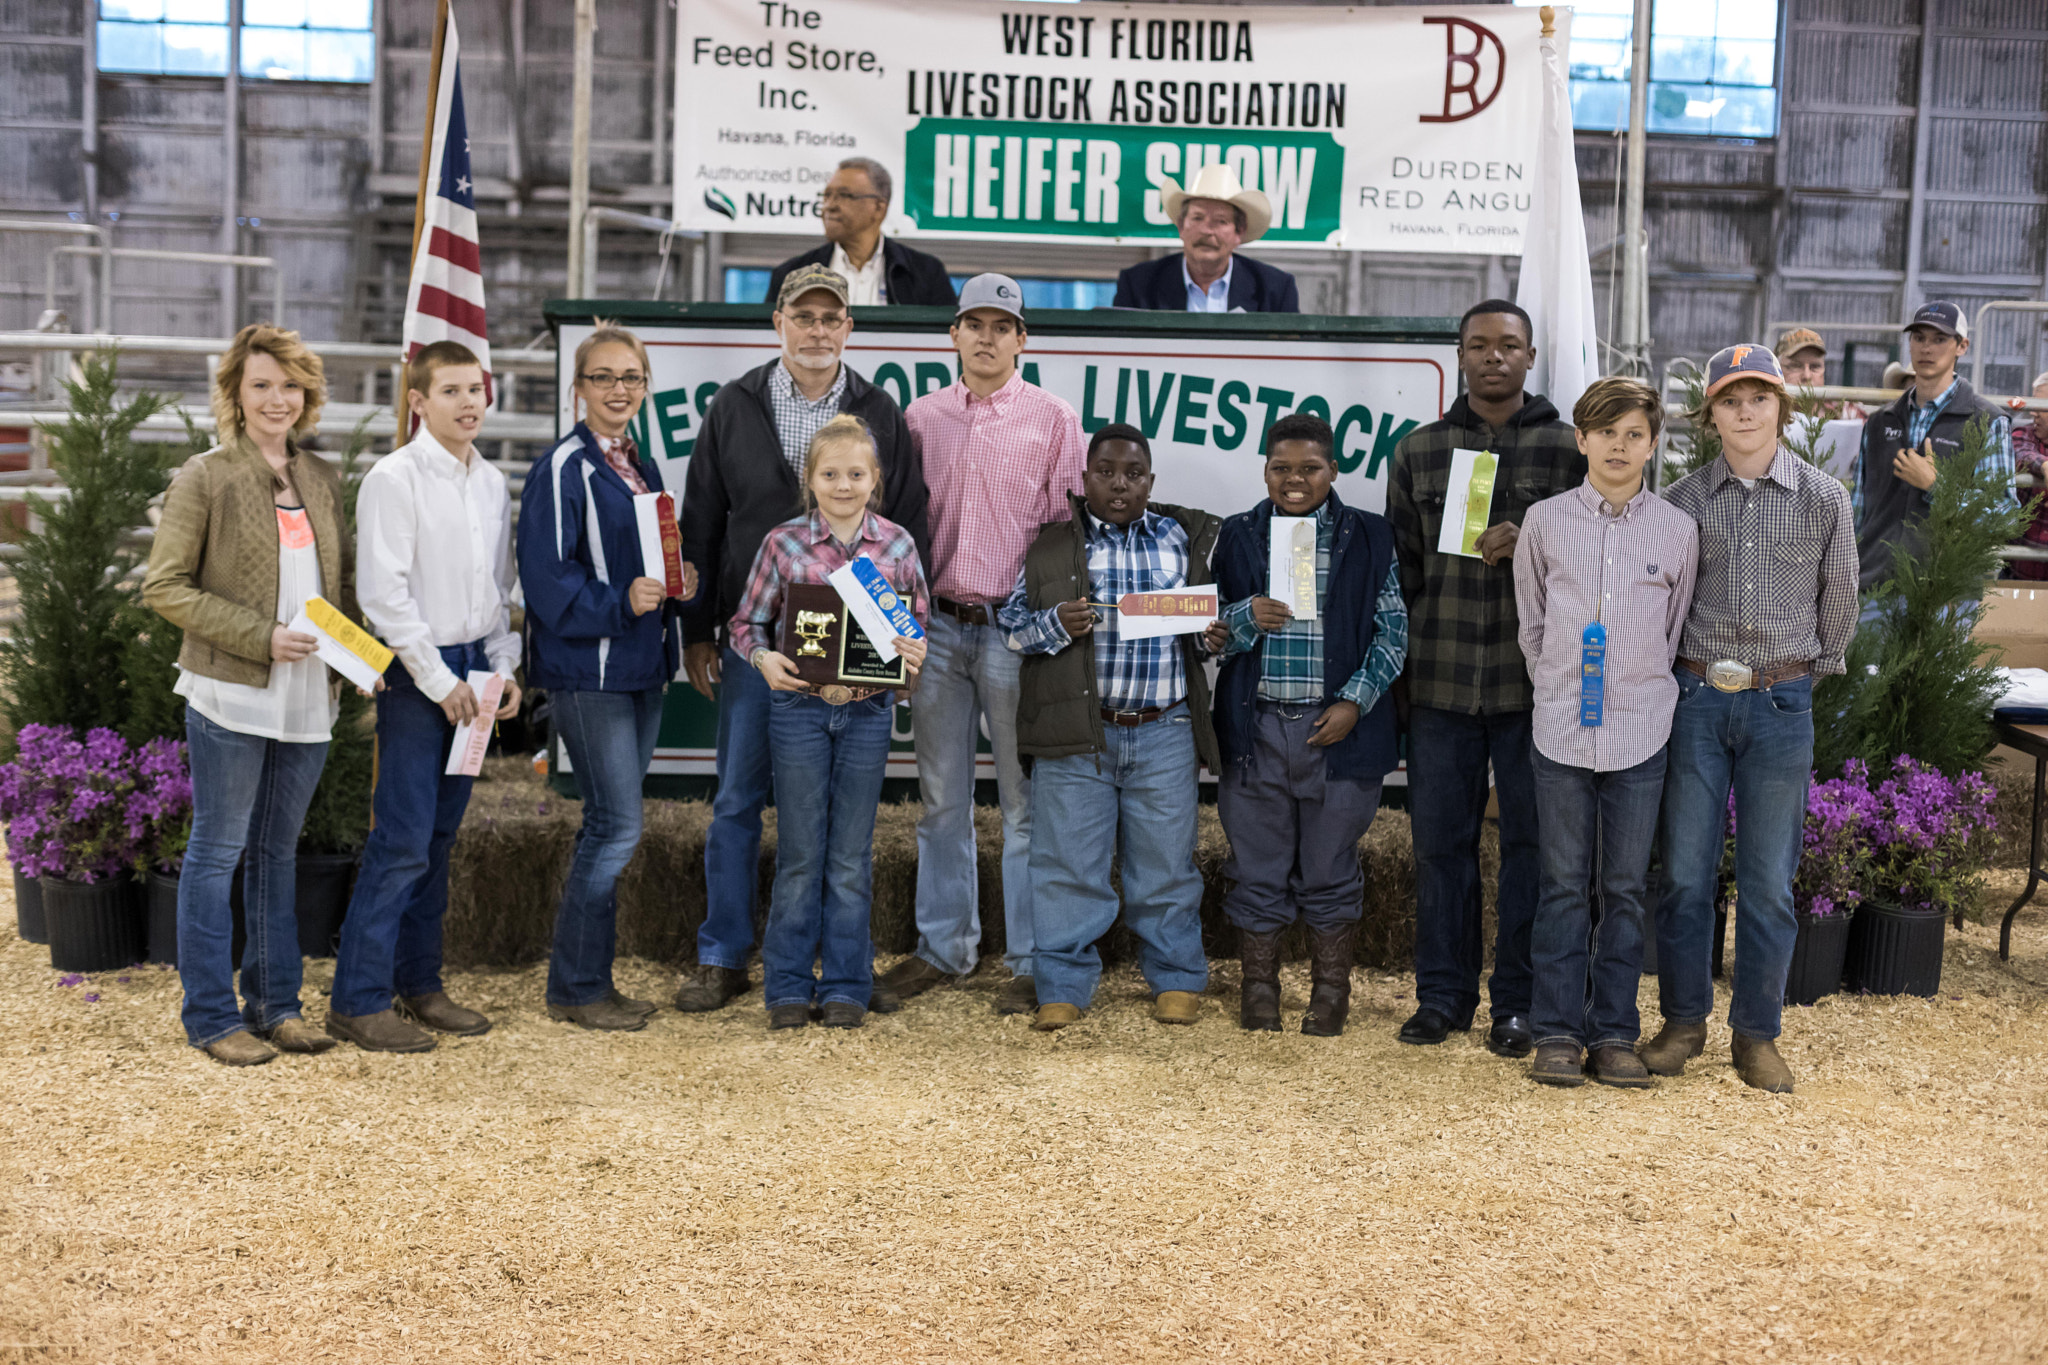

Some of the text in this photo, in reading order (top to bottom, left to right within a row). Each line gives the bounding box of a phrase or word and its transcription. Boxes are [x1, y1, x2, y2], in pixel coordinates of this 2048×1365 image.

[759, 0, 821, 30] The
[1001, 13, 1254, 62] WEST FLORIDA
[693, 37, 884, 78] Feed Store,
[758, 81, 817, 111] Inc.
[908, 70, 1346, 128] LIVESTOCK ASSOCIATION
[718, 128, 857, 148] Havana, Florida
[696, 165, 833, 183] Authorized Dea
[933, 133, 1121, 224] HEIFER
[1392, 156, 1523, 181] DURDEN
[1359, 186, 1532, 212] RED ANGU
[1457, 222, 1520, 237] FLORIDA
[1729, 347, 1753, 368] F
[1081, 365, 1420, 481] LIVESTCK
